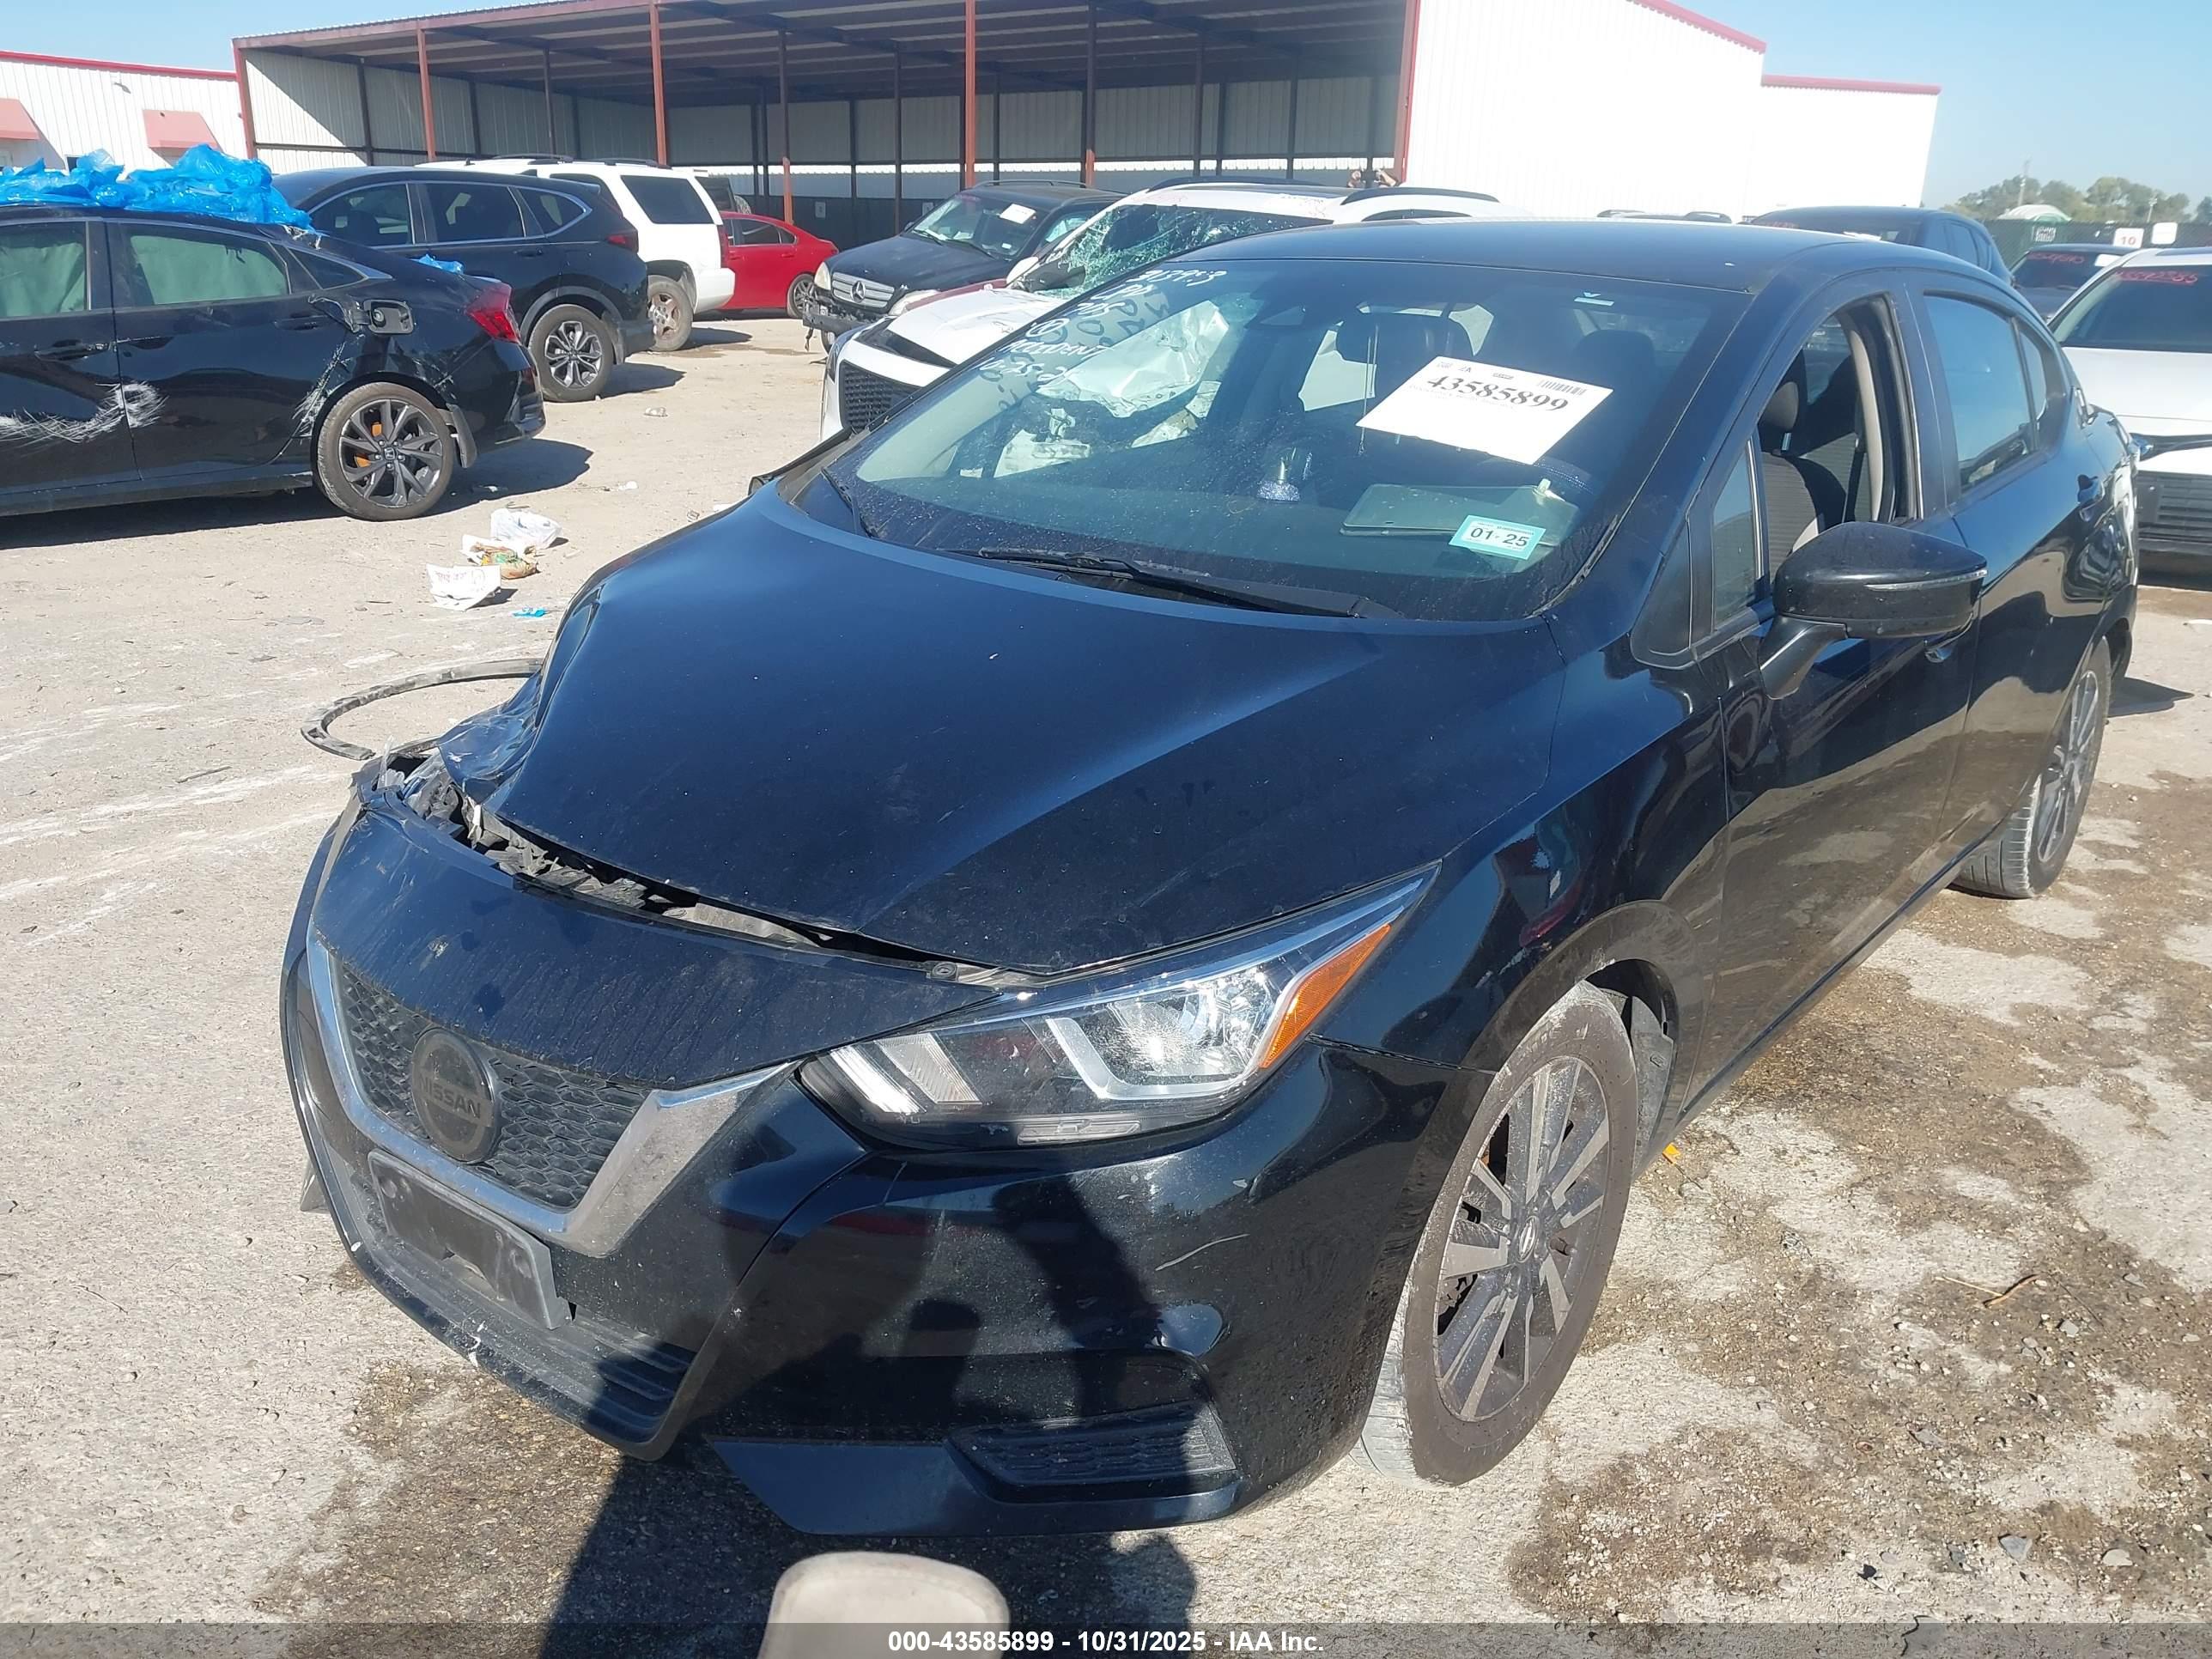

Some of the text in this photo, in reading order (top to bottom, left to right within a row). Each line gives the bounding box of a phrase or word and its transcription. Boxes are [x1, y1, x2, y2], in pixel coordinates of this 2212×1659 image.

[2120, 236, 2136, 246] 10
[993, 337, 1115, 360] ACCIDENT
[970, 356, 1073, 383] 10-25-2
[1427, 375, 1570, 411] 43585899
[1470, 526, 1494, 540] 01
[1502, 532, 1530, 547] 25
[419, 1075, 482, 1119] NISSAN
